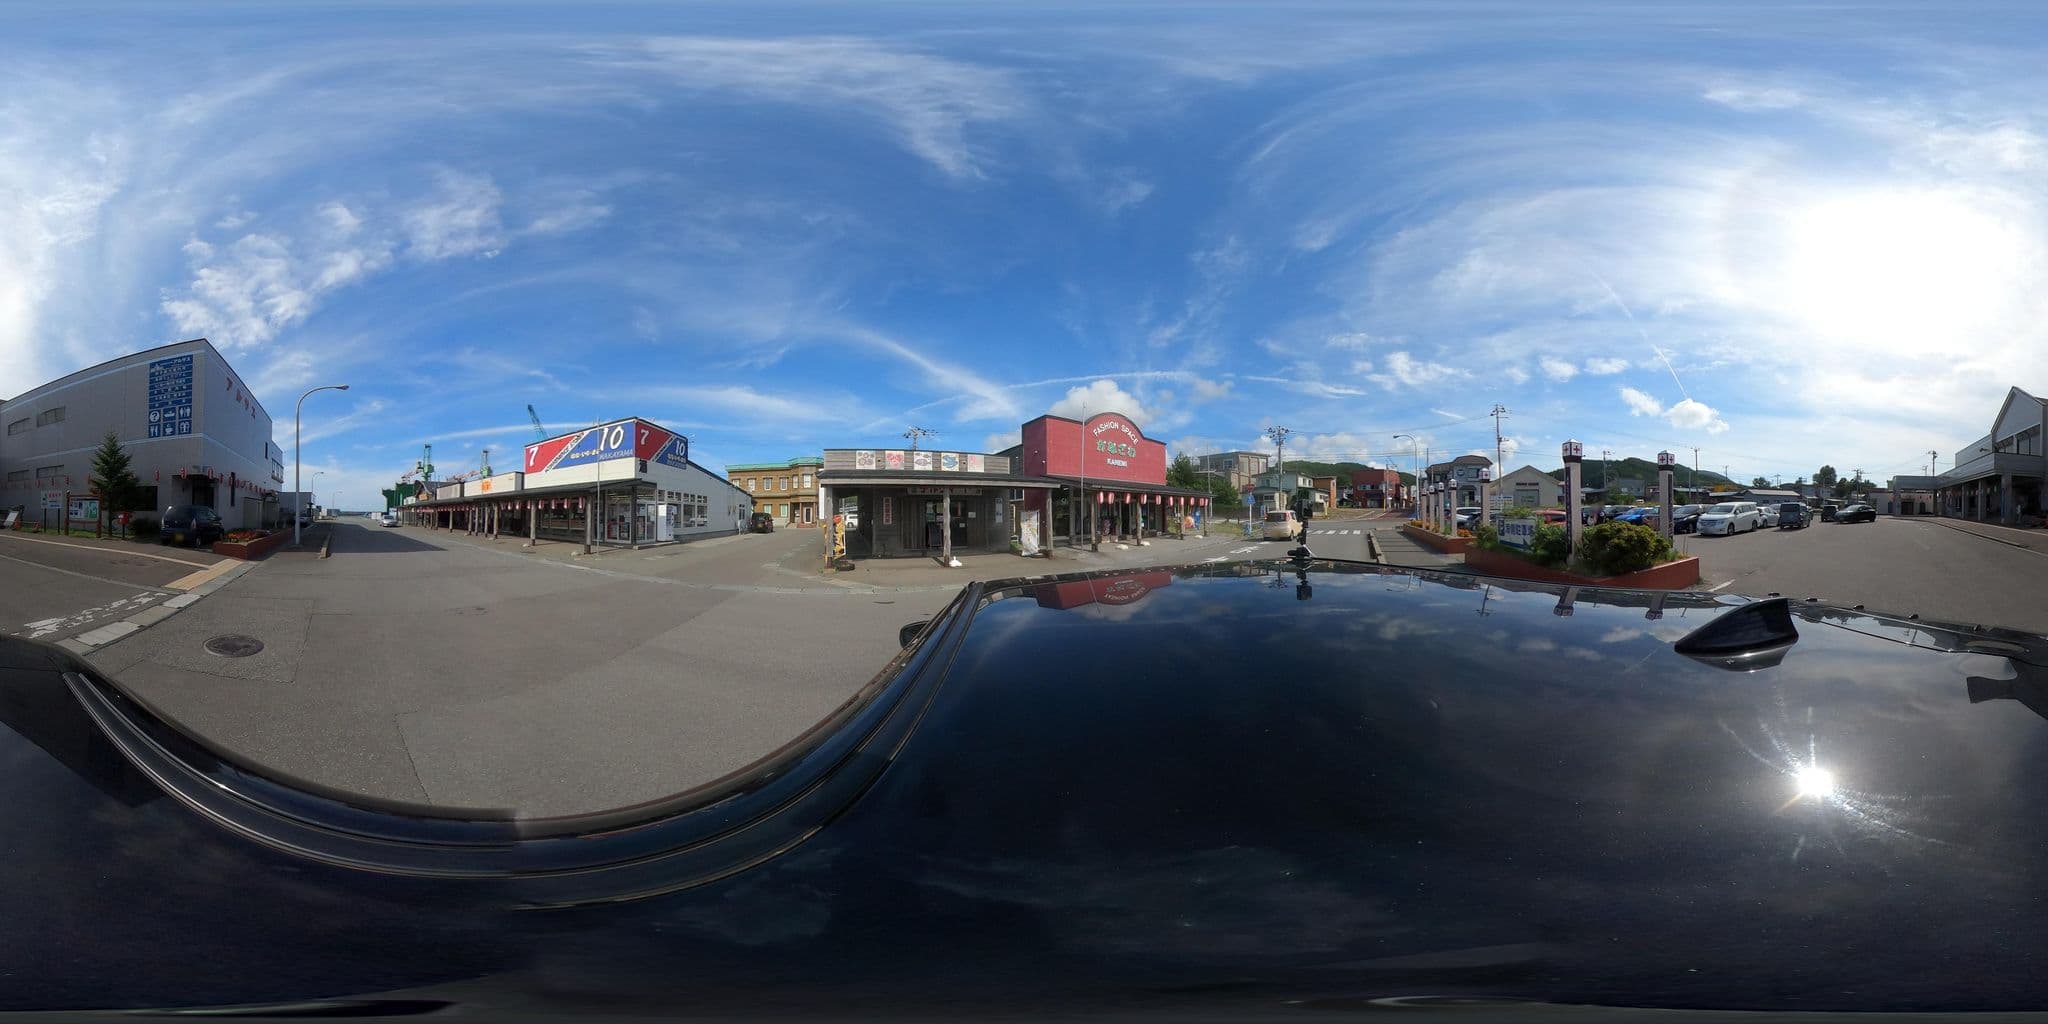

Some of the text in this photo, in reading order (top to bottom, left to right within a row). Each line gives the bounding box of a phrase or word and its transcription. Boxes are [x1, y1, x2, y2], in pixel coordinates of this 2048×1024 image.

[529, 446, 539, 467] 7
[600, 426, 624, 451] 10
[640, 429, 650, 446] 7
[675, 440, 686, 456] 10
[1093, 421, 1138, 445] FASHION SPACE
